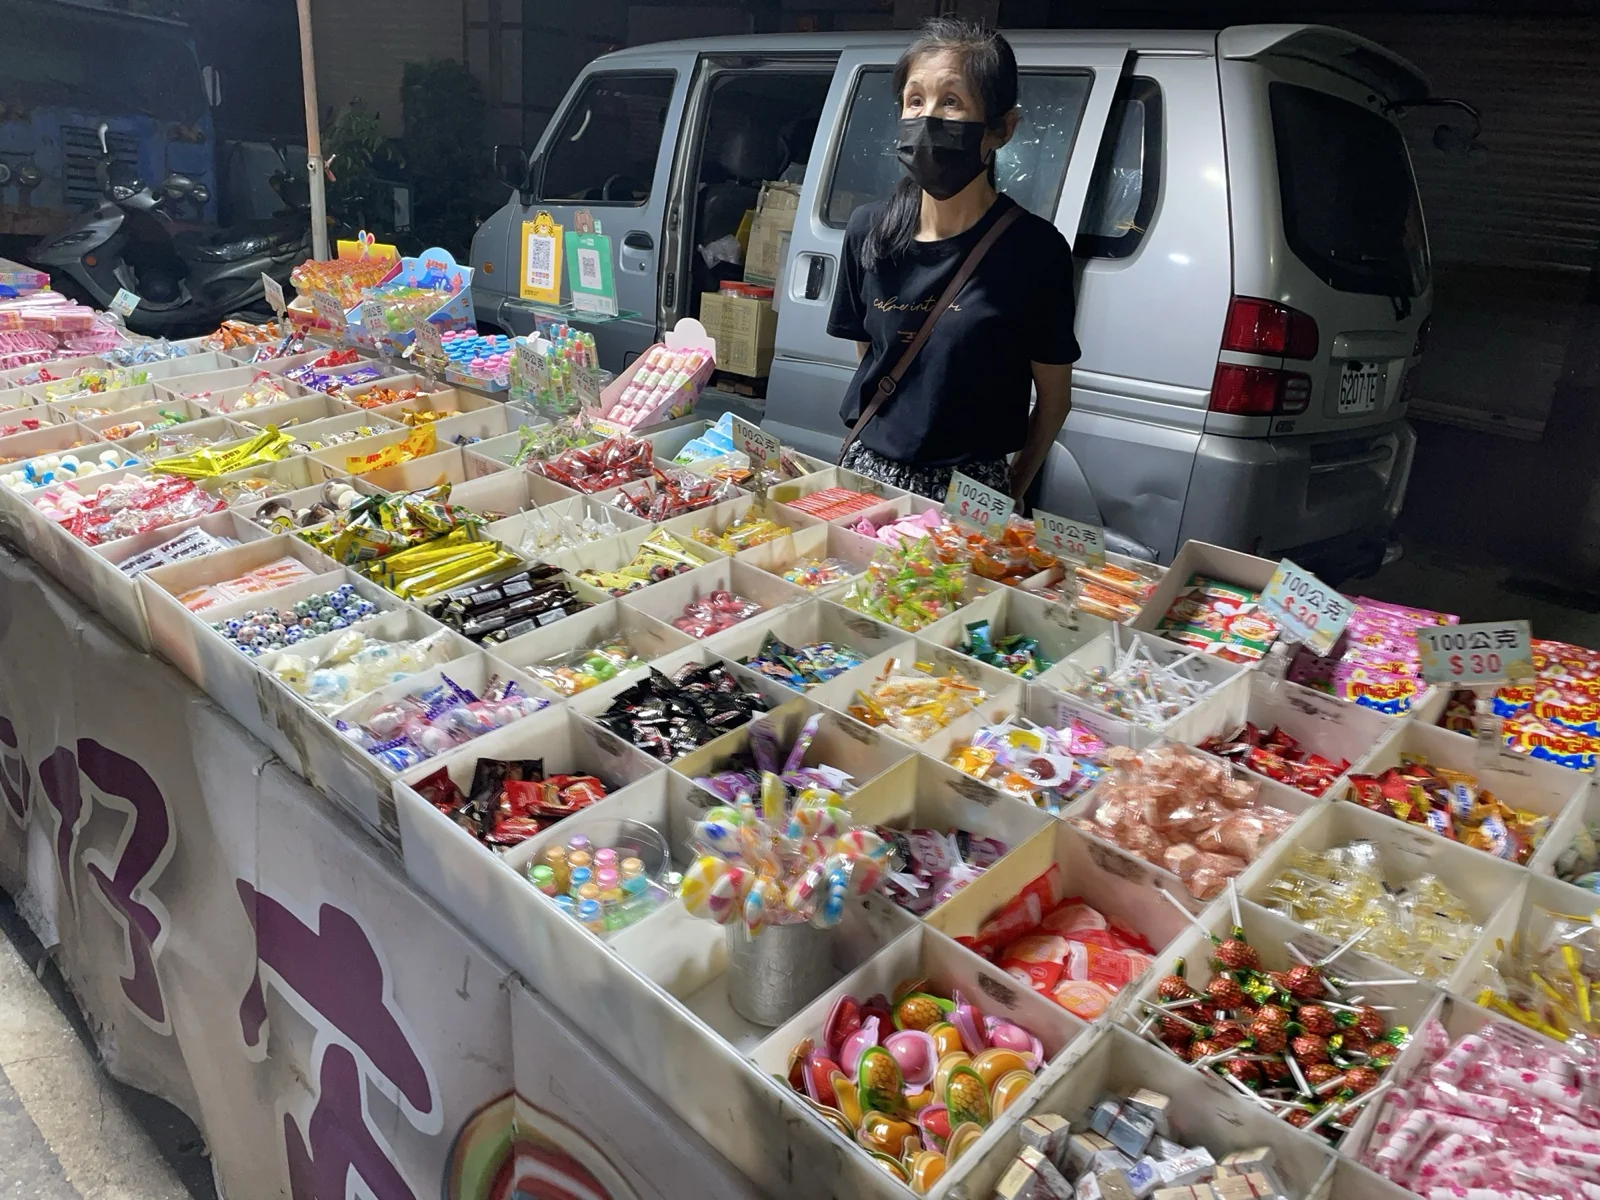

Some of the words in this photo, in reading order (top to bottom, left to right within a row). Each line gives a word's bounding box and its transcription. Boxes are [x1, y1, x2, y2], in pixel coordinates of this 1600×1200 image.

[737, 424, 776, 453] 100公克
[956, 481, 1007, 516] 100公克
[959, 500, 990, 526] $40
[1041, 517, 1099, 545] 100公克
[1281, 571, 1346, 622] 100公克
[1428, 629, 1519, 651] 100公克
[1447, 653, 1502, 675] $30
